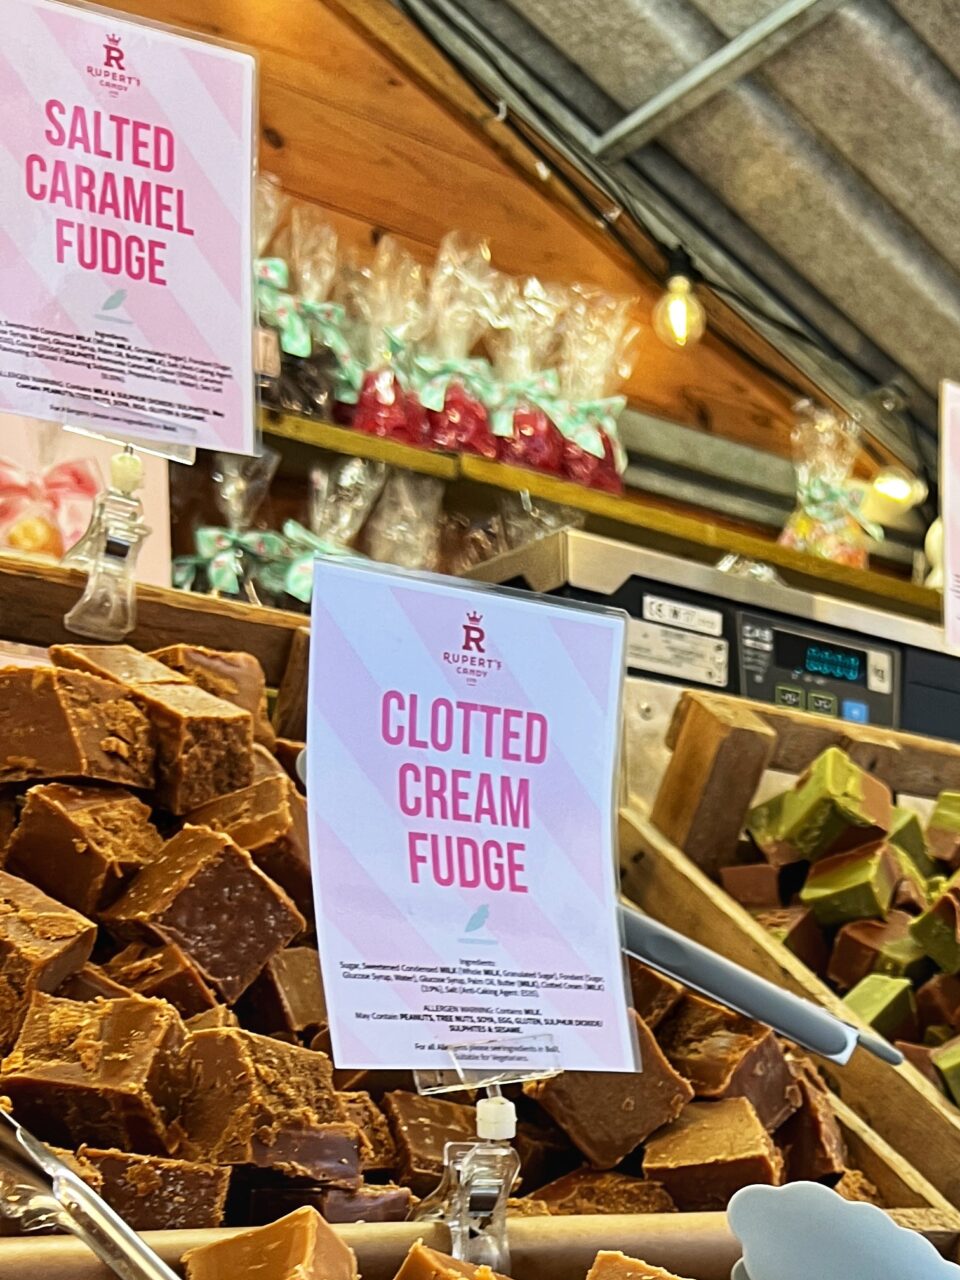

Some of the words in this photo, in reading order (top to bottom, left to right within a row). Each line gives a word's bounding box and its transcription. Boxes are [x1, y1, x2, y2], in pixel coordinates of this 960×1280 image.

[102, 43, 125, 71] R
[45, 99, 174, 173] SALTED
[25, 153, 195, 236] CARAMEL
[56, 218, 167, 286] FUDGE
[462, 624, 485, 653] R
[381, 690, 548, 765] CLOTTED
[398, 762, 530, 829] CREAM
[408, 831, 528, 893] FUDGE
[440, 966, 456, 974] MILK
